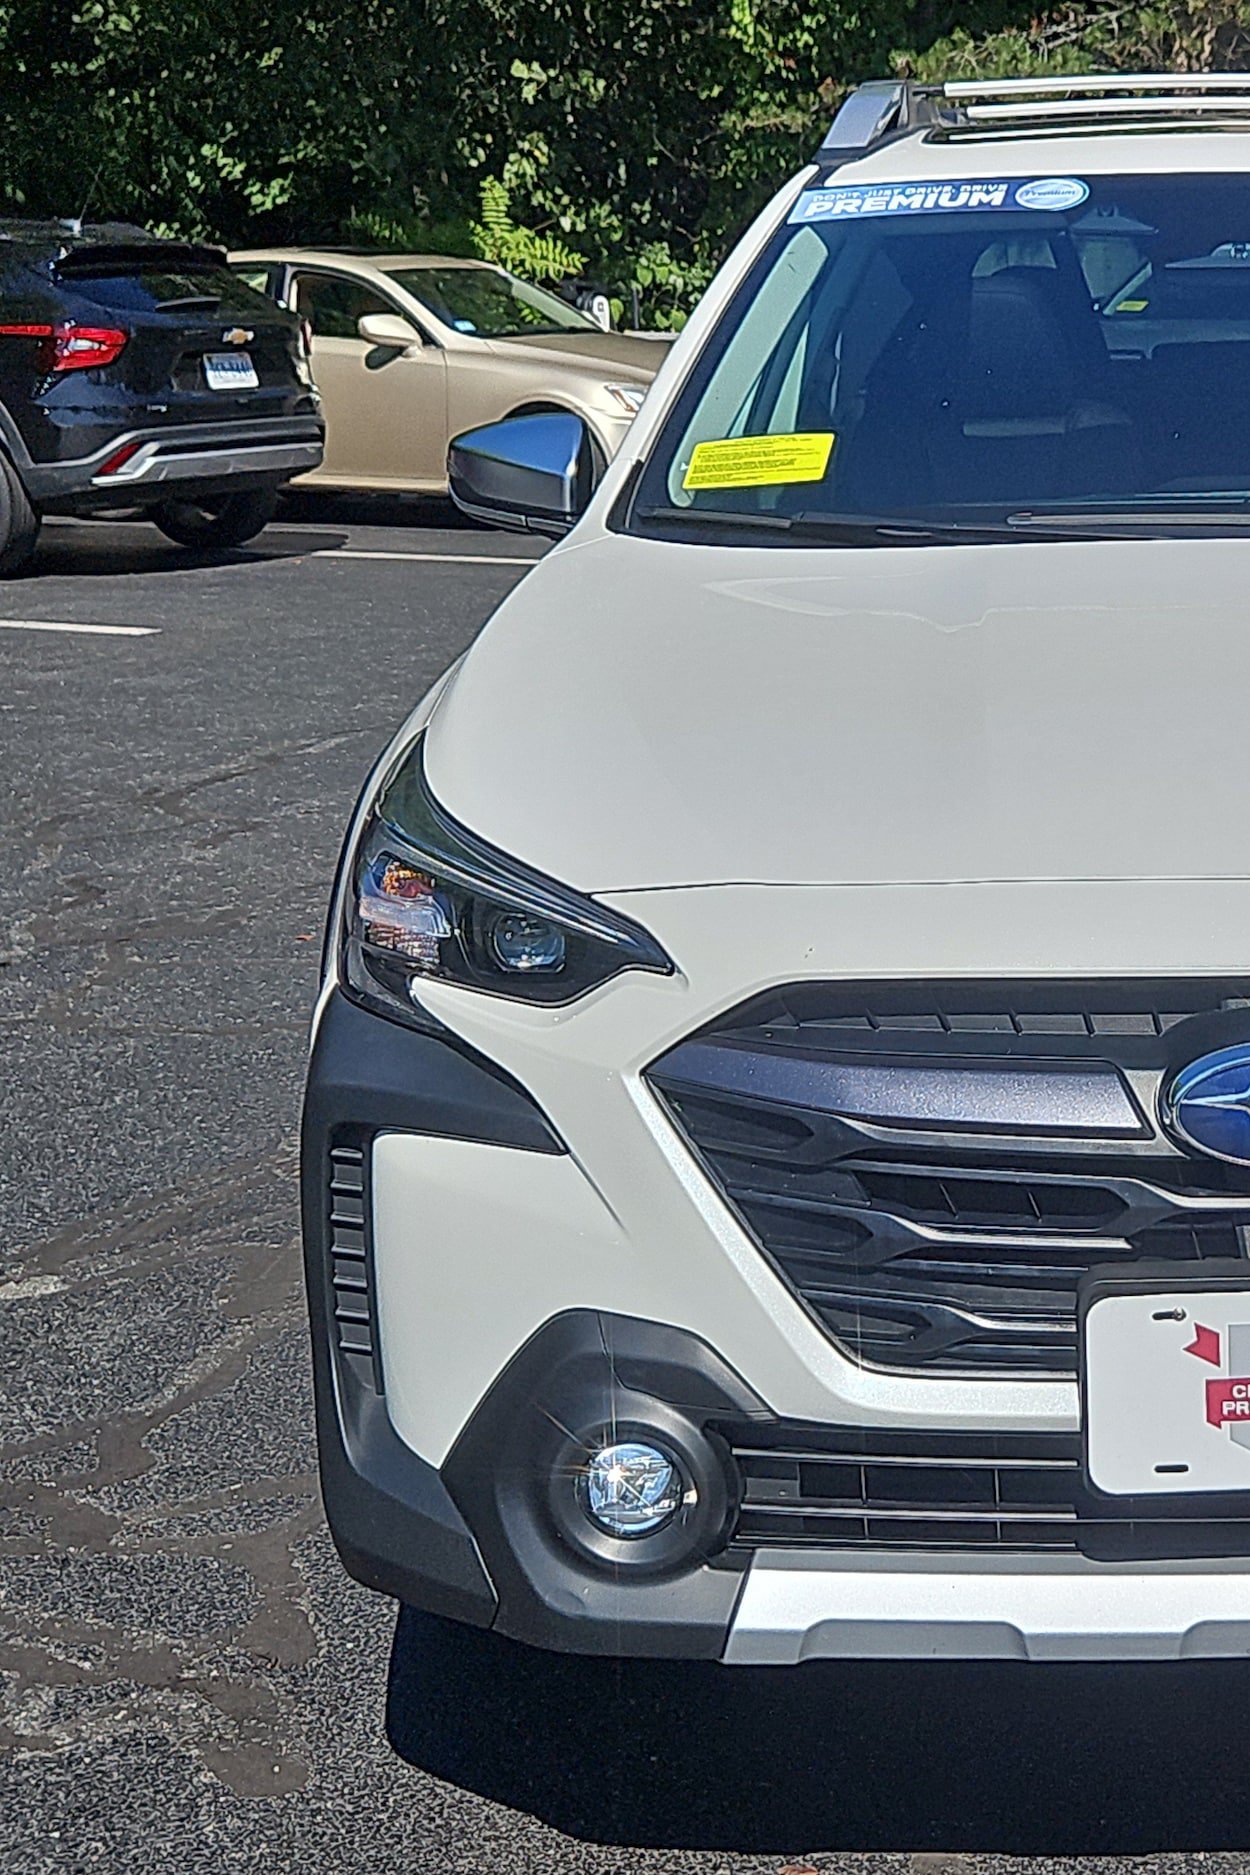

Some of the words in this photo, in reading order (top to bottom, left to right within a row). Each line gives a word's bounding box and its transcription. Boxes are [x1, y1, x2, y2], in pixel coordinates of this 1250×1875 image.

[803, 191, 1006, 217] PREMIUM
[813, 192, 861, 202] DON'T
[864, 188, 902, 198] JUST
[960, 184, 1008, 192] DRIVE
